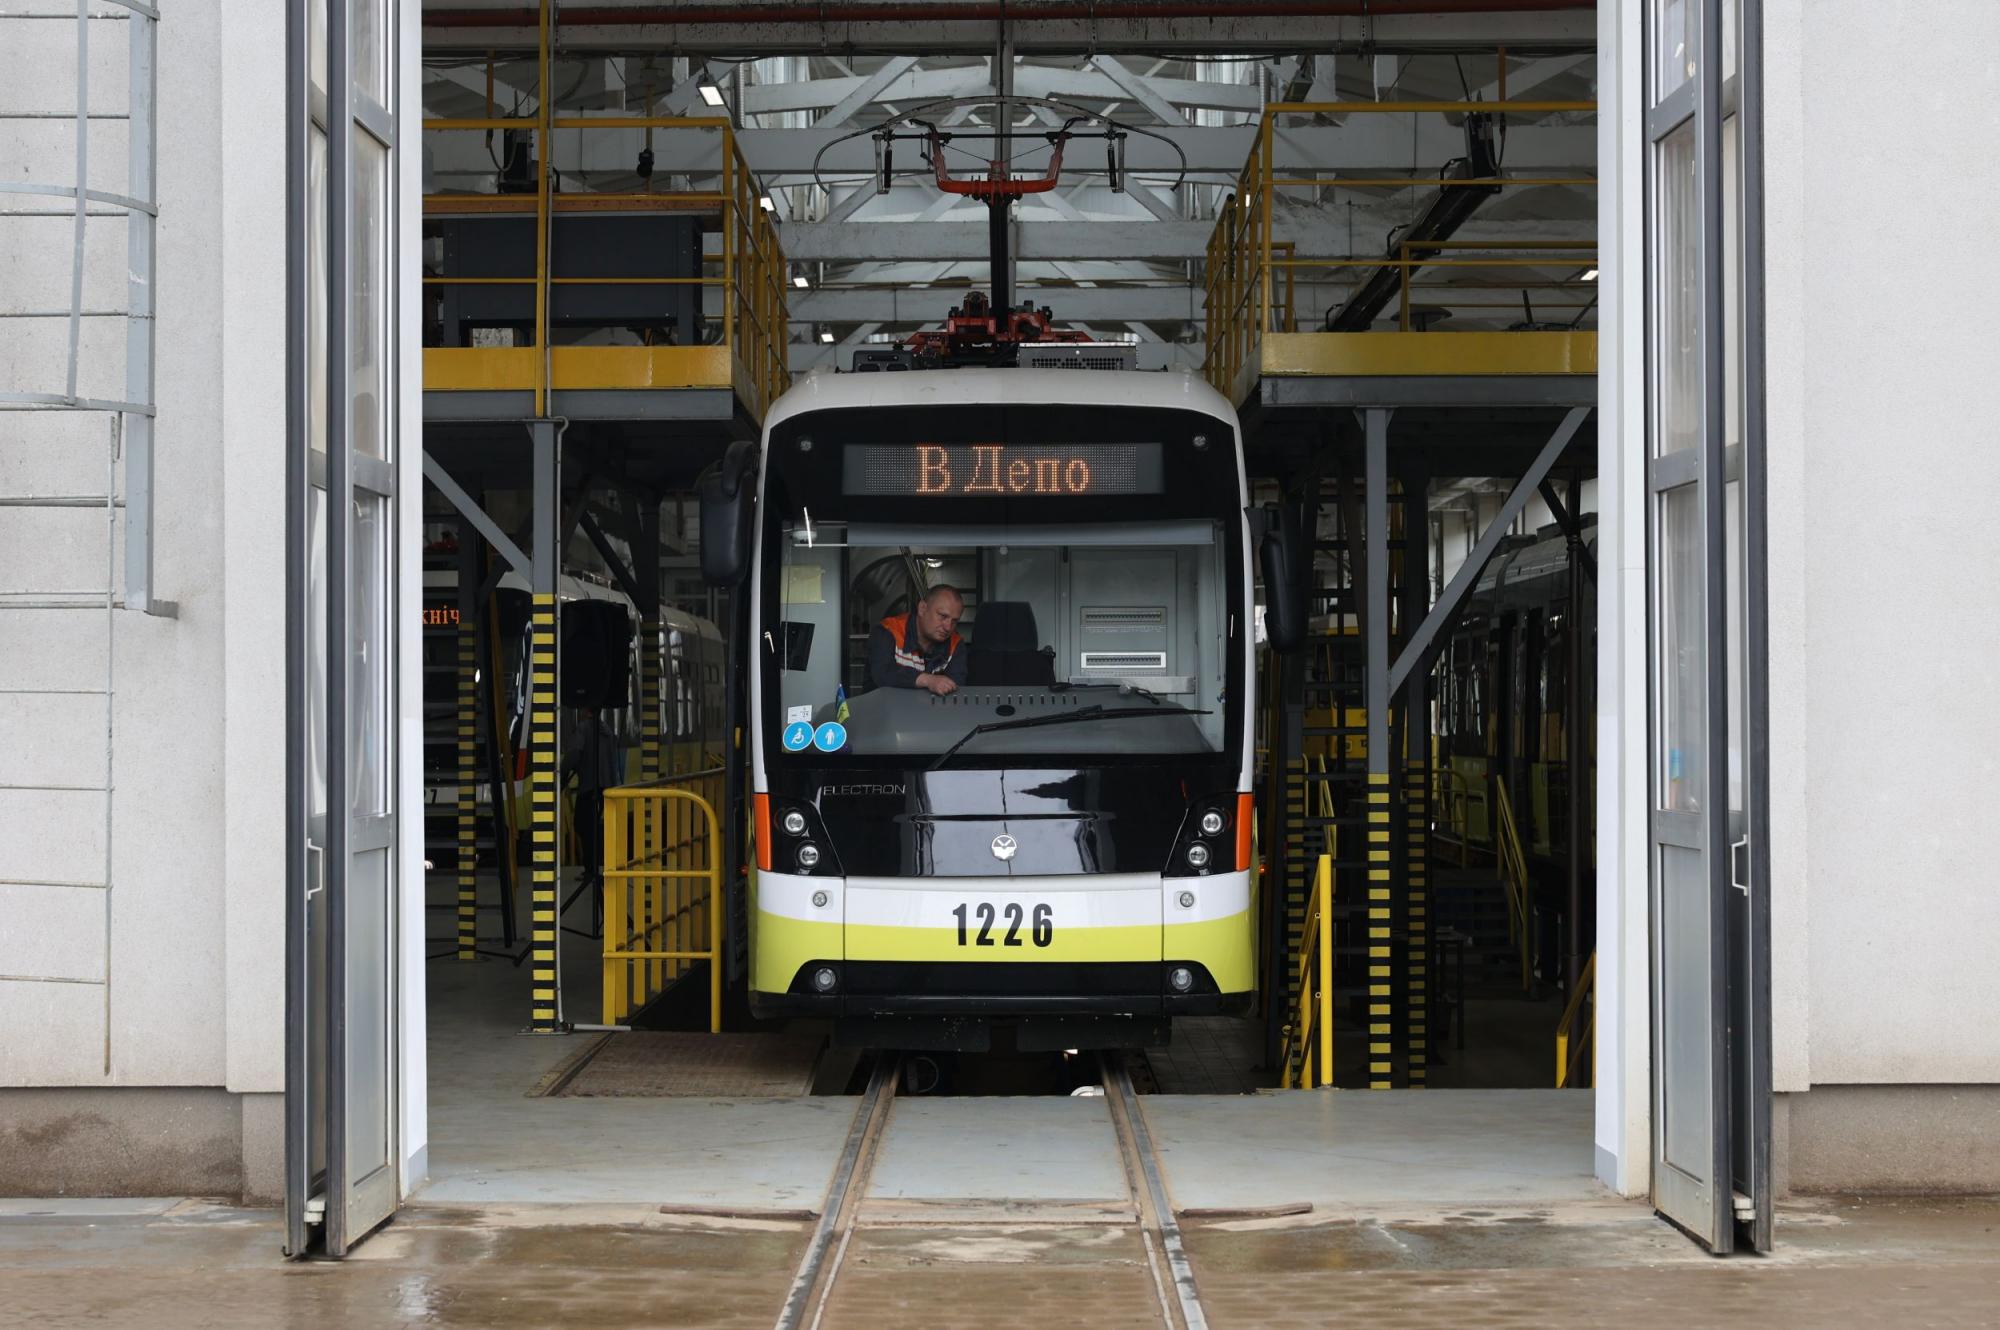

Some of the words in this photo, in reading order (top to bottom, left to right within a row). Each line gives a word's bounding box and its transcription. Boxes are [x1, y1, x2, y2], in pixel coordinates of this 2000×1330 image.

[916, 446, 950, 492] В
[964, 446, 1089, 492] Депо
[823, 784, 906, 796] ELECTRON
[952, 902, 1053, 947] 1226
